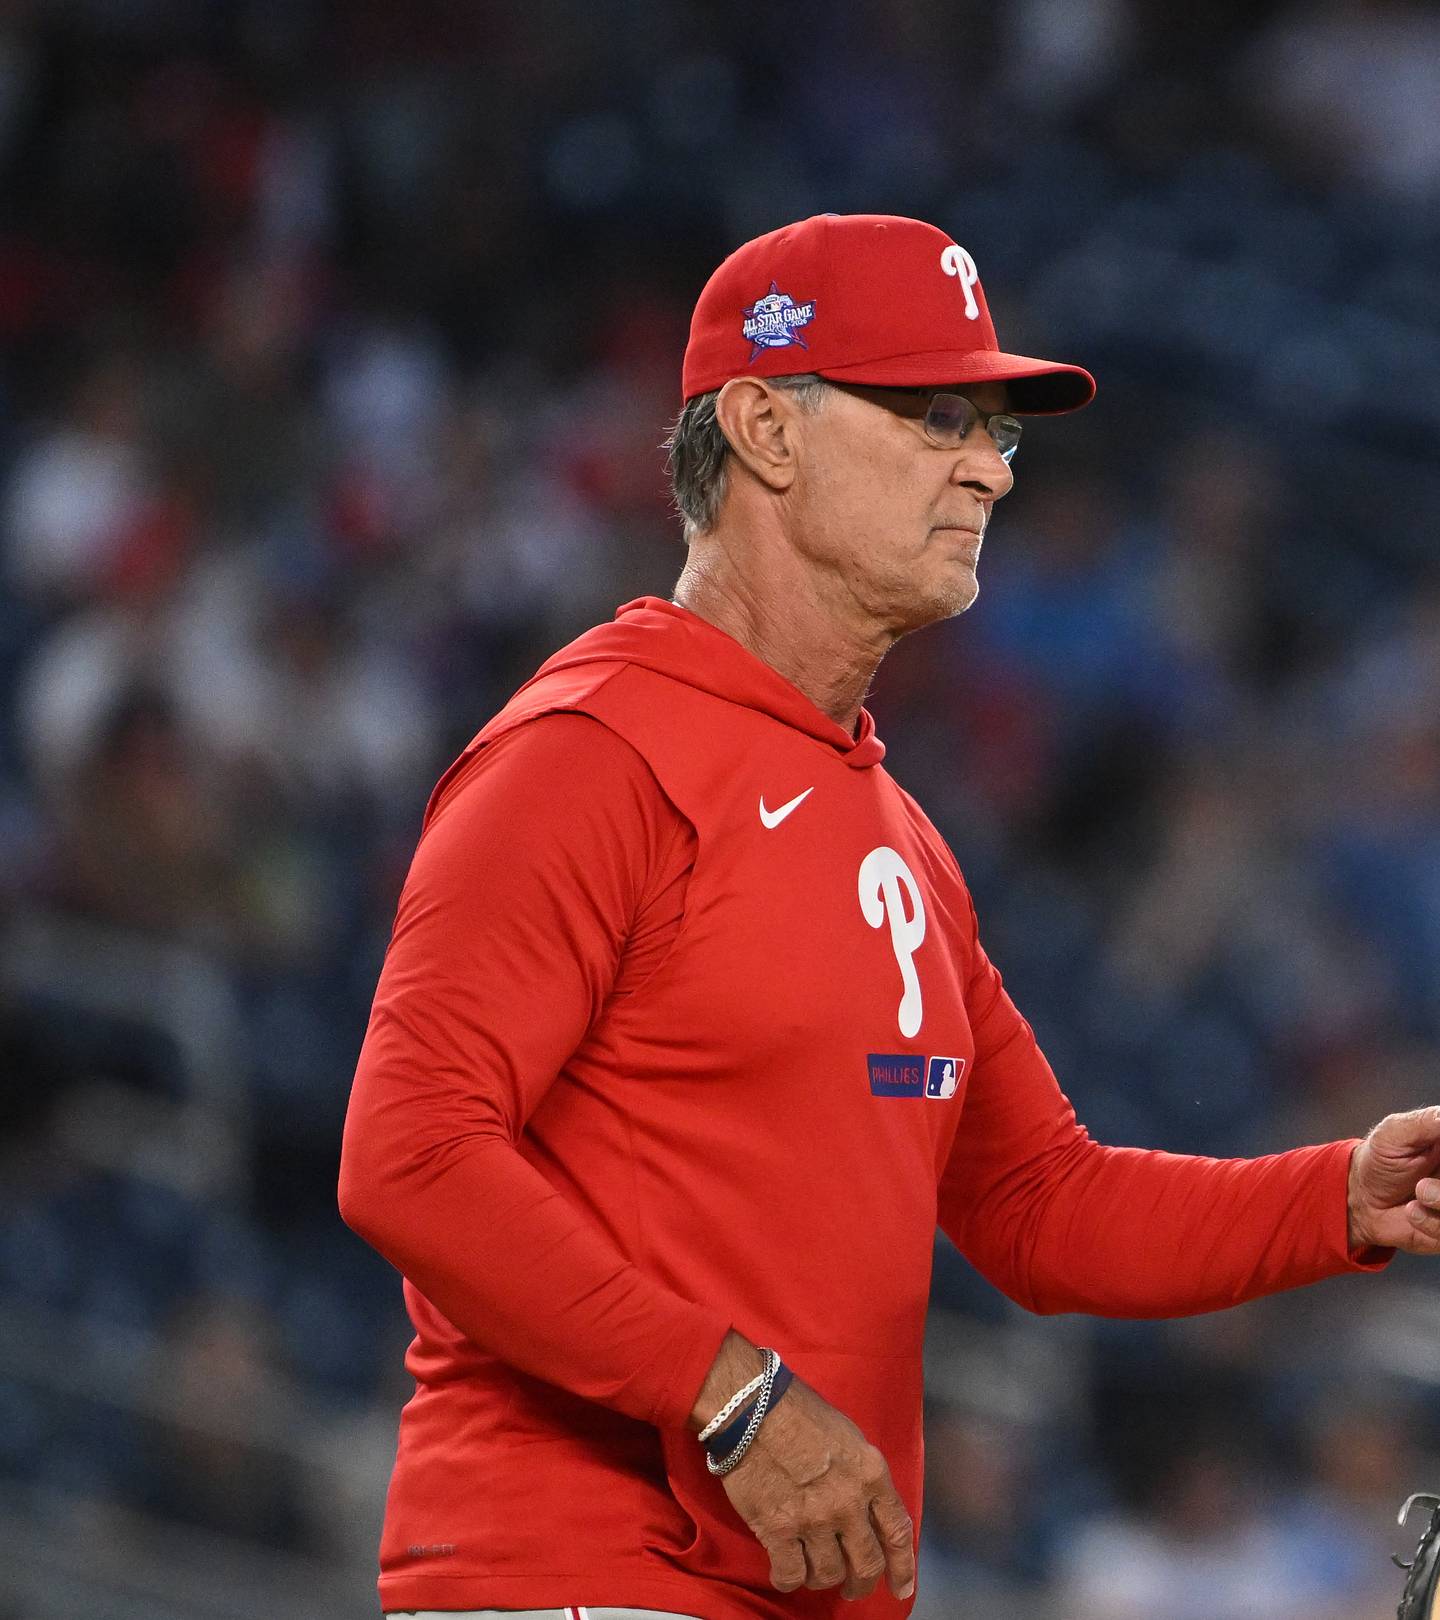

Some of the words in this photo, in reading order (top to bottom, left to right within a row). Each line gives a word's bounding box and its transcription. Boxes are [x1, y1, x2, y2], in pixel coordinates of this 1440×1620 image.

[940, 245, 979, 320] P
[743, 318, 758, 335] ALL
[757, 311, 784, 328] STAR
[783, 304, 813, 322] GAME
[858, 846, 926, 1038] P
[872, 1066, 920, 1085] PHILLIES
